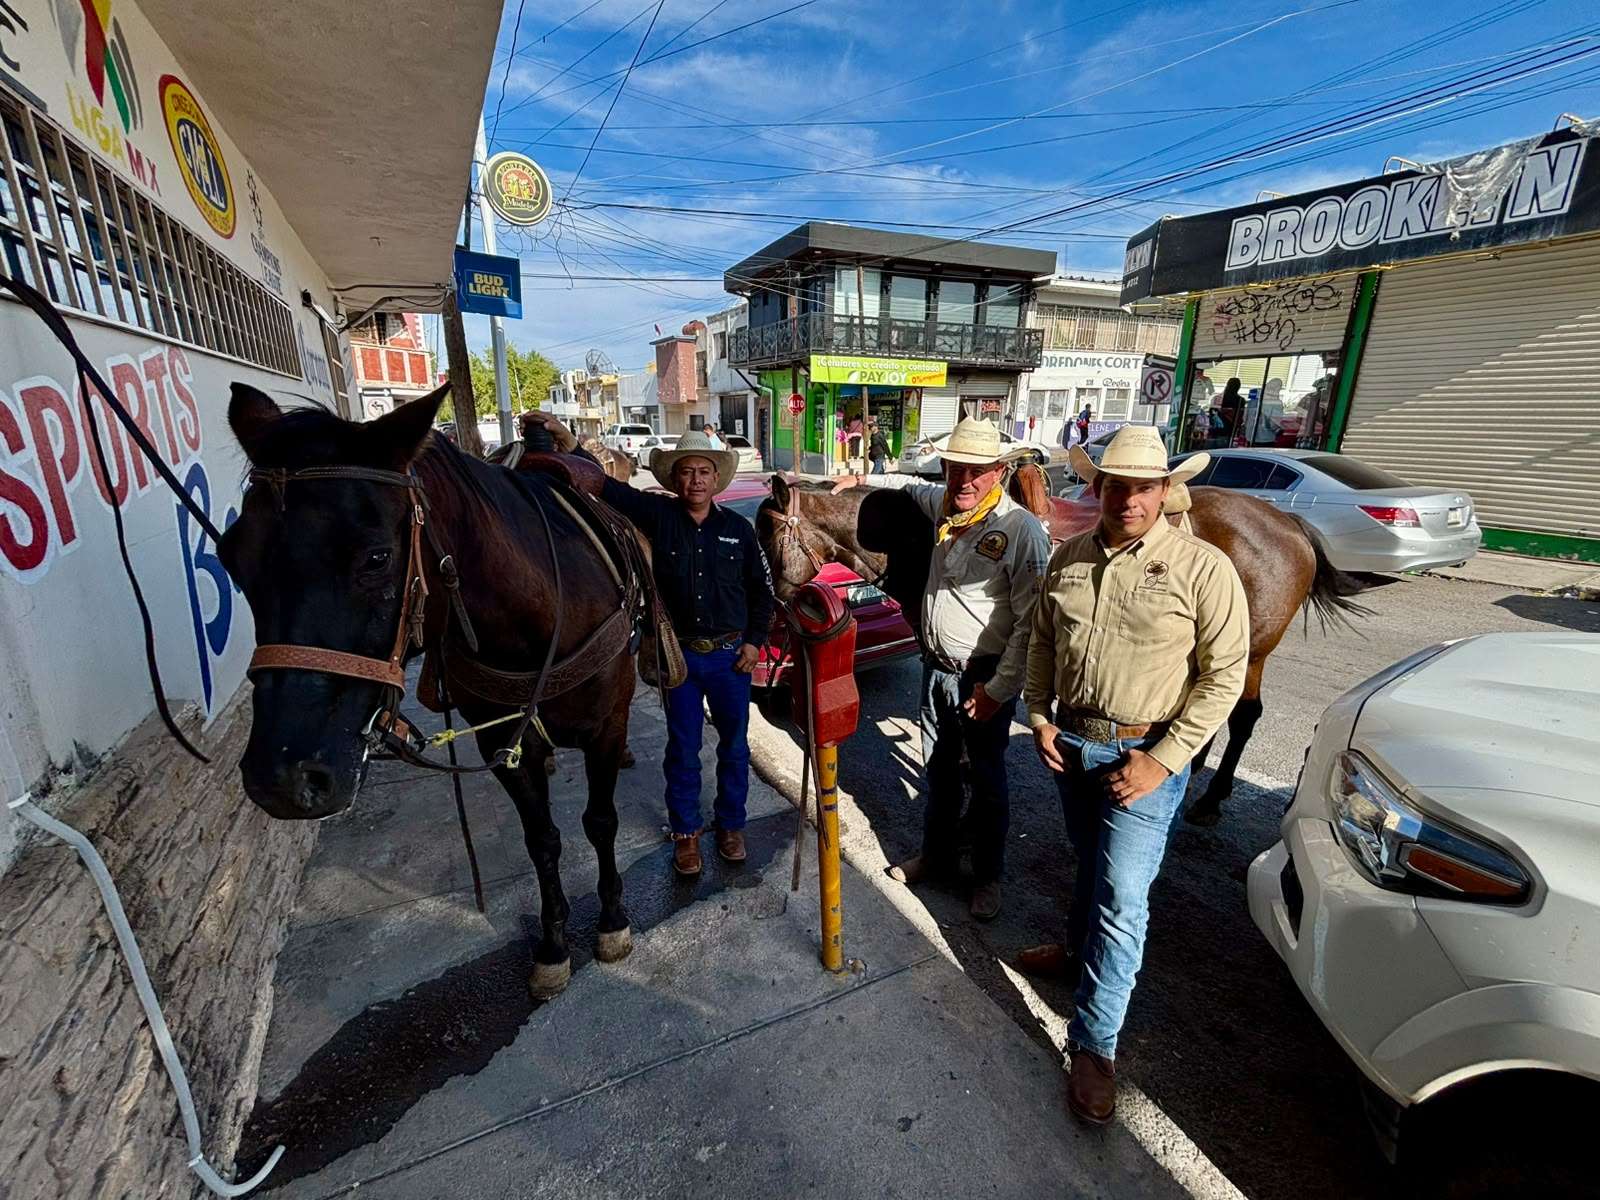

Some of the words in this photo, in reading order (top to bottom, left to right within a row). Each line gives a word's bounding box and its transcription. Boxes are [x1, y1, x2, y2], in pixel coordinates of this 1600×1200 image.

[65, 79, 128, 169] LIGA
[473, 272, 504, 287] BUD
[468, 282, 509, 298] LIGHT
[789, 399, 804, 410] ALTO
[0, 347, 201, 571] SPORTS
